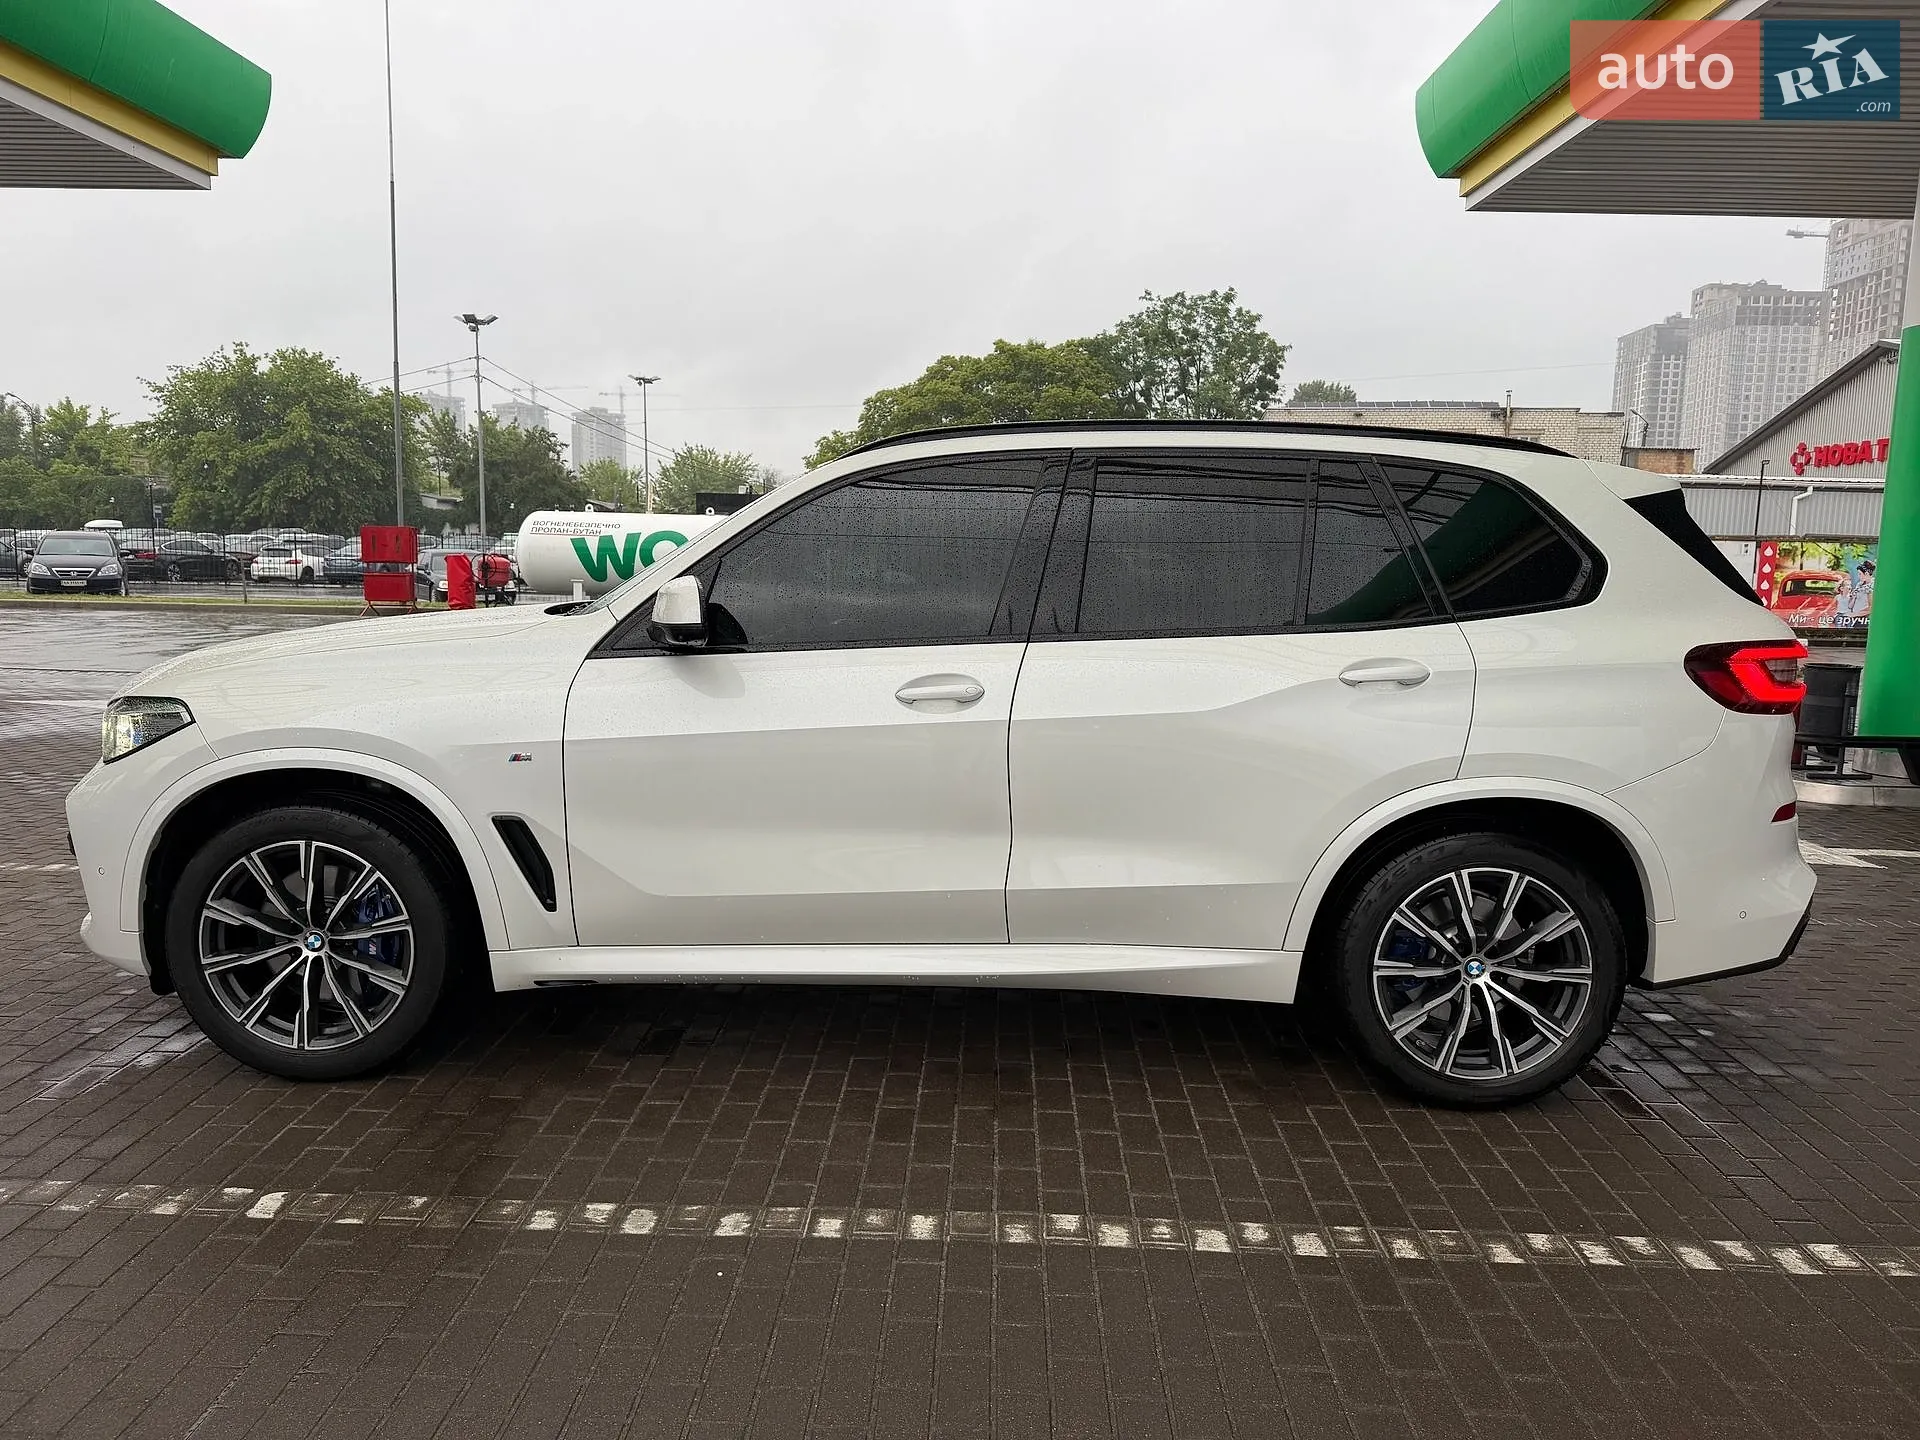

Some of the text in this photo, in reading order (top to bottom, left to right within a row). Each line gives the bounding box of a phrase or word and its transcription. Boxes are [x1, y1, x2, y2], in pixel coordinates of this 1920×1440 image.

[1813, 441, 1872, 467] НОВА
[532, 520, 621, 529] ВОГНЕНЕБЕЗПЕЧНО
[531, 527, 602, 535] ПРОПАН-БУТАН
[1788, 613, 1807, 624] Ми
[1818, 615, 1835, 626] це
